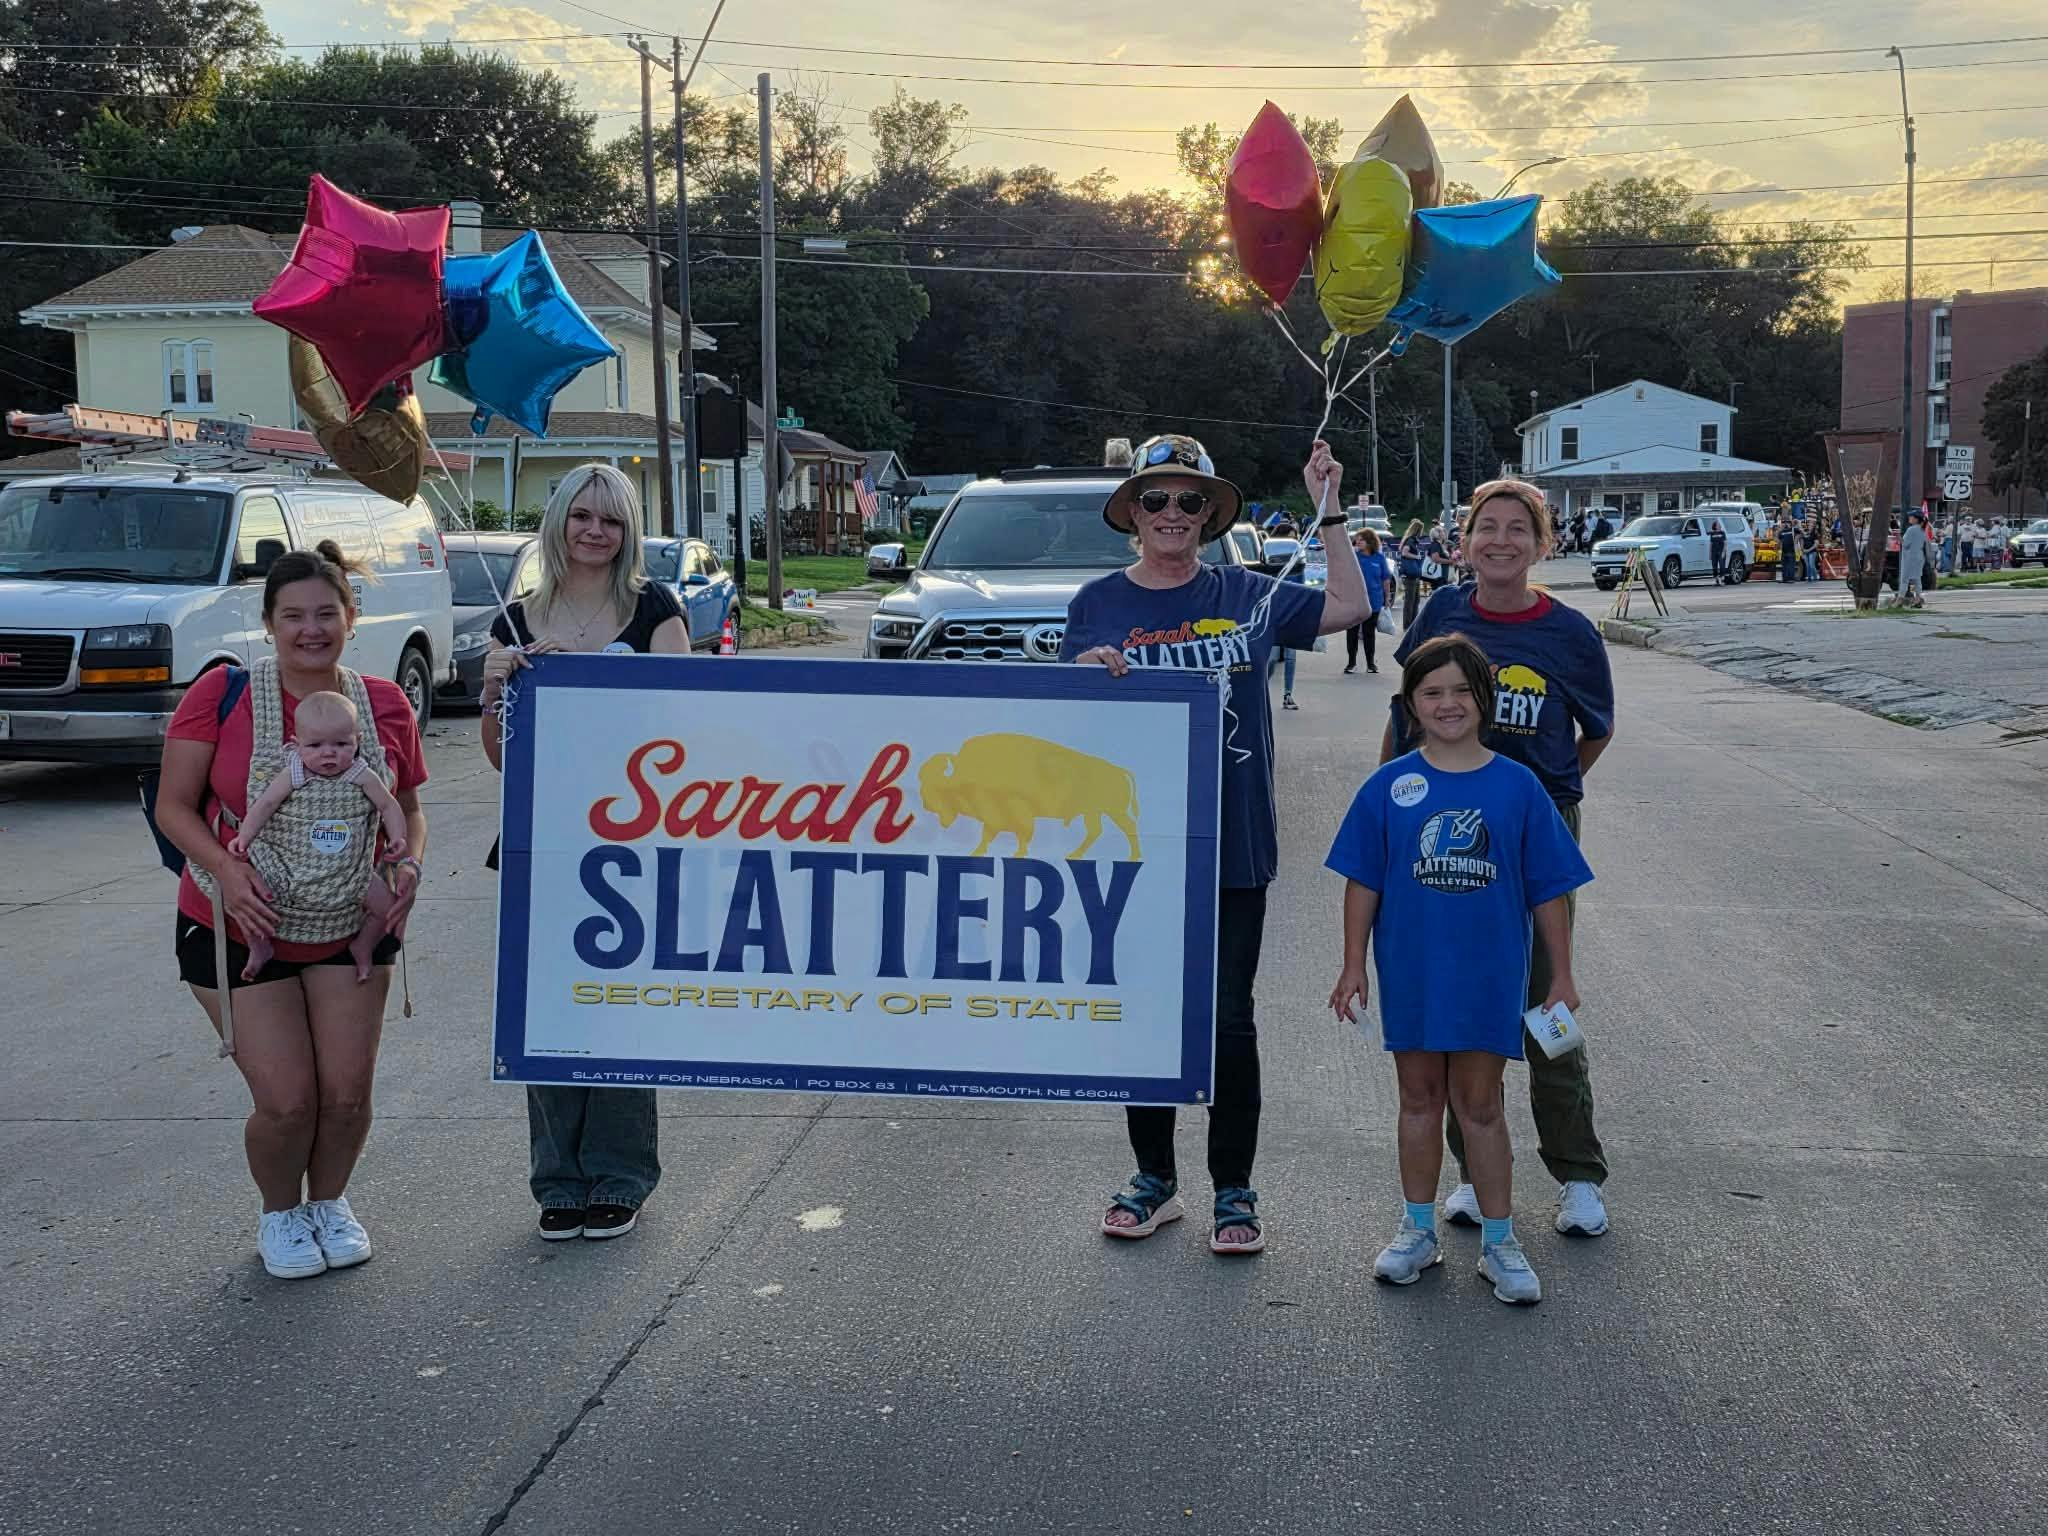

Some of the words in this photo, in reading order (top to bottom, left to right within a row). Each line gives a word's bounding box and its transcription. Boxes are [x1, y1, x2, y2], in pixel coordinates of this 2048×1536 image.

[1954, 449, 1968, 457] TO
[1947, 479, 1969, 495] 75
[1123, 621, 1197, 648] Sarah
[1123, 633, 1252, 669] SLATTERY
[588, 737, 916, 844] Sarah
[312, 831, 347, 841] SLATTERY
[1412, 856, 1497, 880] PLATTSMOUTH
[1421, 877, 1488, 888] VOLLEYBALL
[573, 845, 1143, 986] SLATTERY
[572, 983, 863, 1014] SECRETARY
[878, 991, 935, 1016] OF
[966, 995, 1123, 1023] STATE
[572, 1071, 654, 1081] SLATTERY
[658, 1074, 693, 1083] FOR
[696, 1075, 785, 1086] NEBRASKA
[807, 1079, 831, 1088] PO
[834, 1080, 872, 1089] BOX
[875, 1082, 896, 1090] 83
[1047, 1088, 1071, 1097] NE
[1074, 1089, 1131, 1099] 68048
